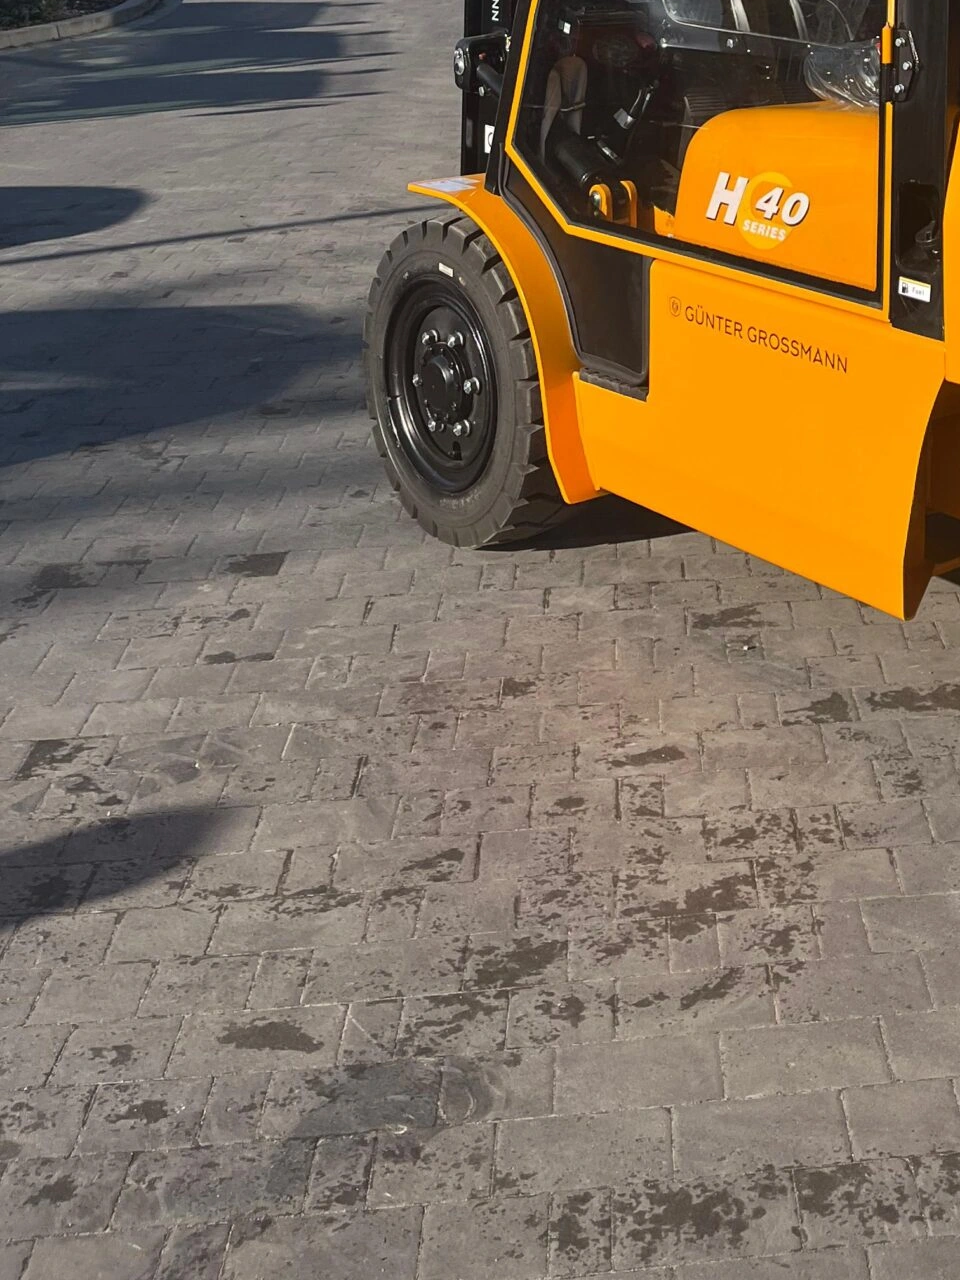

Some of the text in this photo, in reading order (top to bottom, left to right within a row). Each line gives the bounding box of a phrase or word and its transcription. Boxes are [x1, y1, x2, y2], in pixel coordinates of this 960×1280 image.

[705, 171, 810, 227] H 40
[743, 219, 787, 242] SERIES
[684, 304, 848, 374] GÜNTER GROSSMANN
